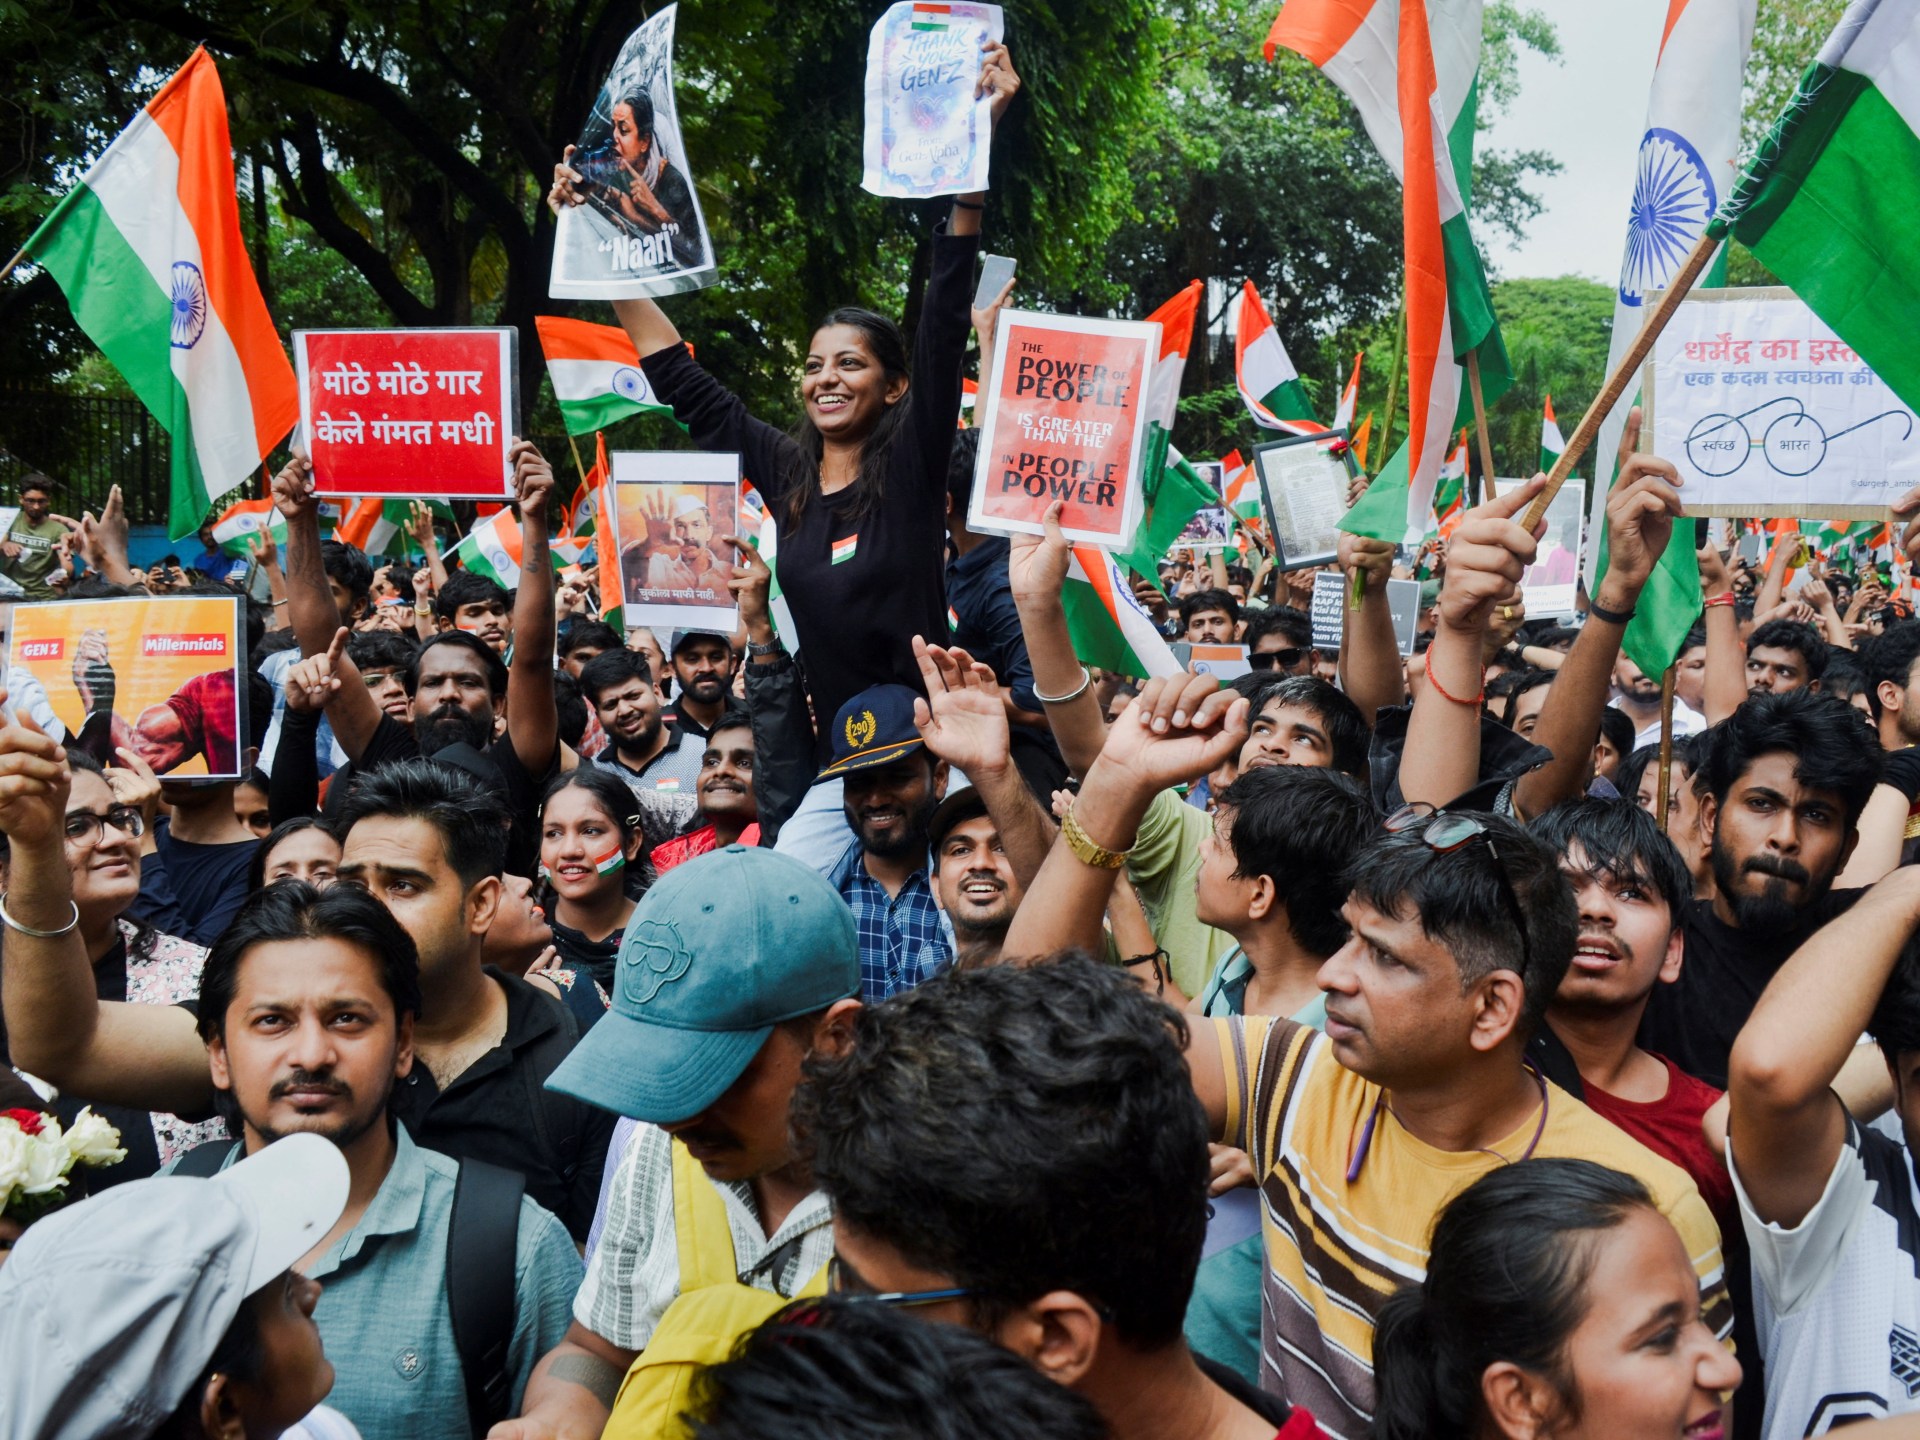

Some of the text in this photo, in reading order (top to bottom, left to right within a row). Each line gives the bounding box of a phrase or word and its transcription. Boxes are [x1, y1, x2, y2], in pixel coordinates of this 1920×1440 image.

[903, 28, 969, 54] THANK
[917, 49, 952, 70] YOU
[1021, 342, 1044, 354] THE
[1684, 332, 1859, 366] धर्मेंद्र का इस्त
[322, 361, 483, 395] मोठे मोठे गार
[1018, 356, 1127, 384] POWER OF
[1684, 366, 1874, 387] एक कदम स्वच्छता की
[1015, 374, 1130, 408] PEOPLE
[316, 411, 495, 445] केले गंमत मधी
[1017, 412, 1113, 436] IS GREATER
[1022, 426, 1105, 448] THAN THE
[1702, 439, 1736, 451] स्वच्छ
[1779, 439, 1811, 451] भारत
[1001, 452, 1118, 483] IN PEOPLE
[1001, 470, 1117, 507] POWER
[672, 587, 695, 599] माफी
[1313, 598, 1333, 606] AAP
[1315, 588, 1344, 598] Congr
[1312, 623, 1343, 633] Accoun
[1331, 632, 1342, 642] fir
[23, 643, 60, 657] GEN Z
[145, 637, 224, 652] Millennials
[851, 720, 868, 736] 290
